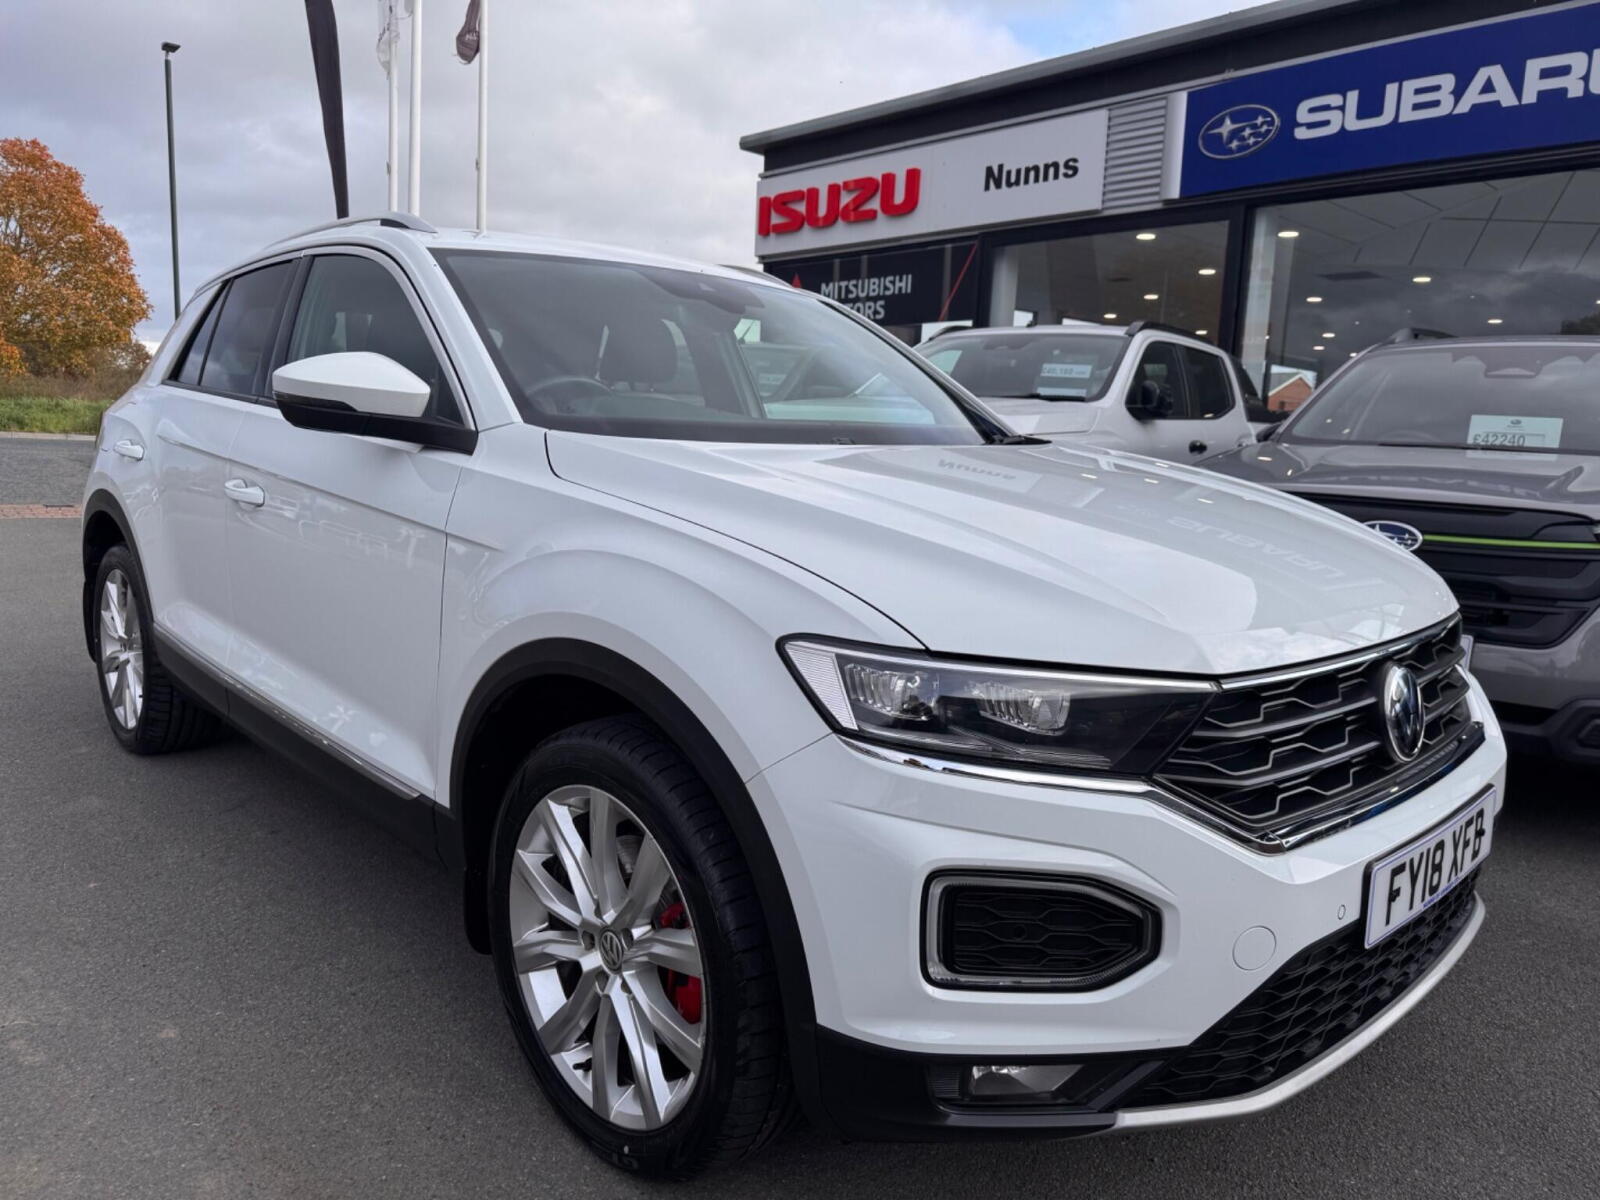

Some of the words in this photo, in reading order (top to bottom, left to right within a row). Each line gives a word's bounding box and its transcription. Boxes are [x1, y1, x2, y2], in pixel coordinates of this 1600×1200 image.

[1294, 48, 1600, 140] SUBAR
[758, 167, 921, 236] ISUZU
[984, 157, 1079, 191] Nunns
[820, 274, 912, 299] MITSUBISHI
[1385, 839, 1445, 926] FY18
[1448, 807, 1485, 882] XFB
